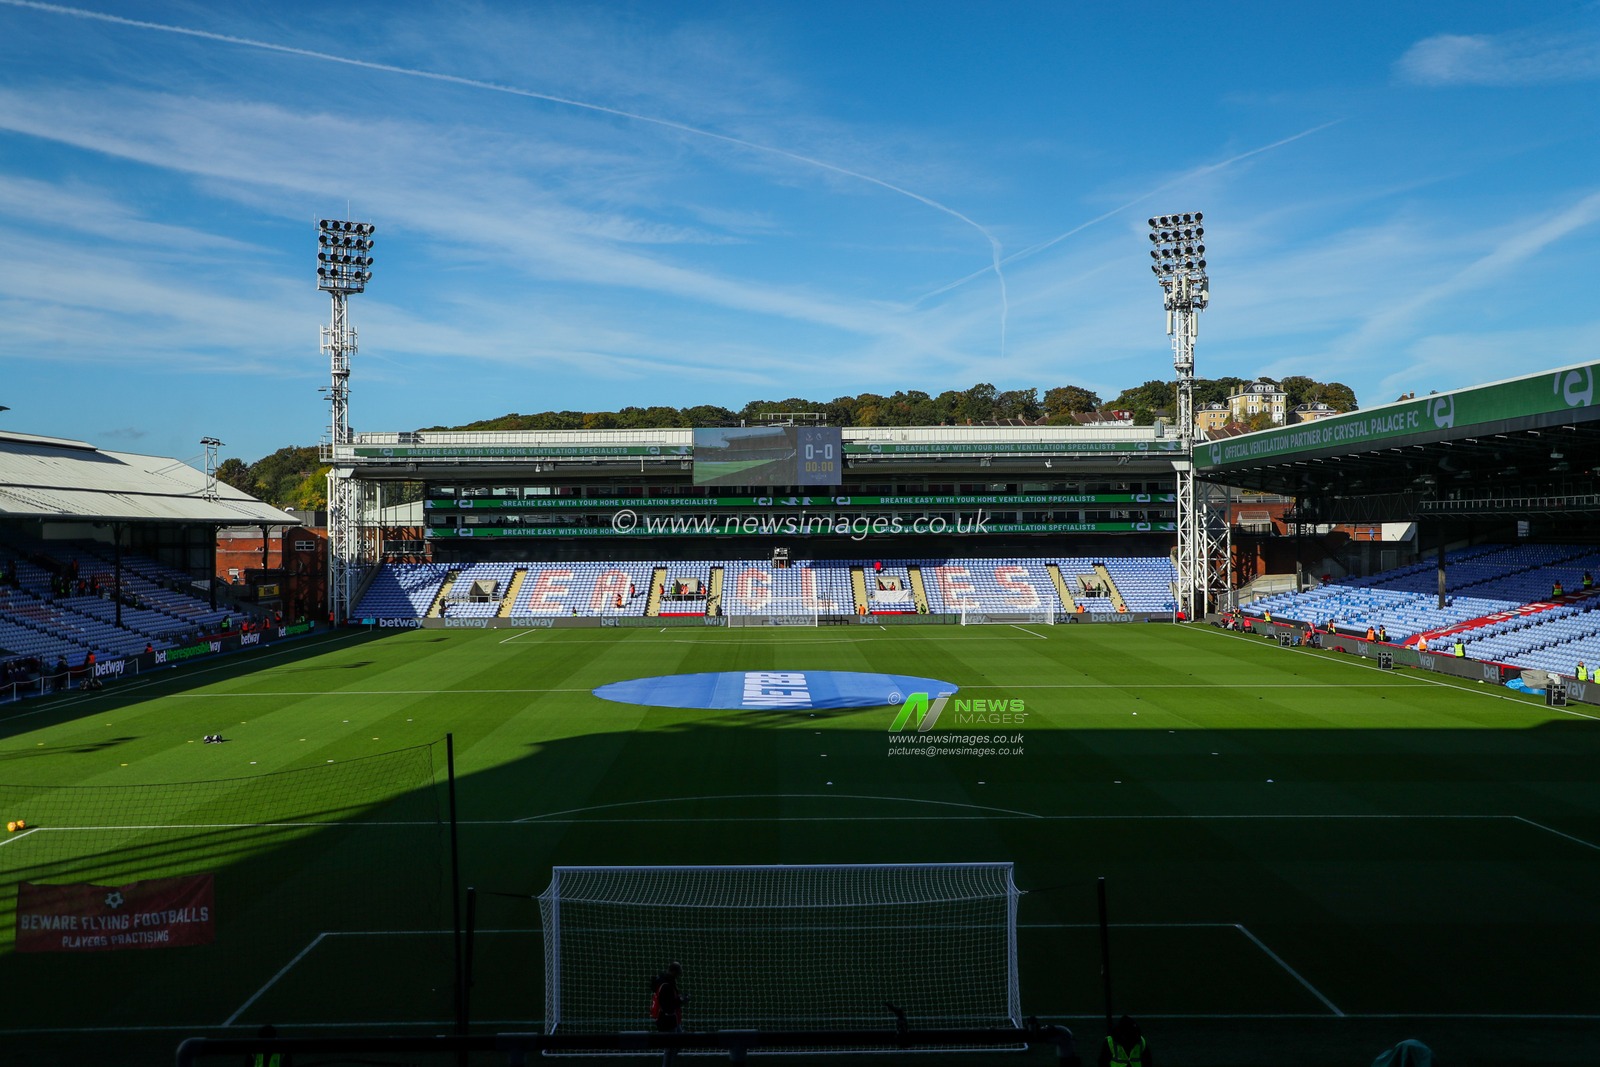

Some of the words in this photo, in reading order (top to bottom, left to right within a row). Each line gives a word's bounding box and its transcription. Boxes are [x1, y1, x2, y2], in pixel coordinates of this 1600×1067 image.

[1224, 446, 1248, 459] OFFICIAL
[1249, 438, 1289, 455] VENTILATION
[1290, 431, 1321, 448] PARTNER
[1322, 428, 1333, 442] OF
[1333, 420, 1369, 441] CRYSTAL
[1370, 412, 1404, 434] PALACE
[1405, 410, 1419, 427] FC
[806, 444, 832, 460] 0-0
[806, 462, 833, 472] 00:00
[379, 617, 423, 629] betway
[444, 617, 489, 628] betway
[510, 617, 555, 628] betway
[768, 615, 812, 626] betway
[1091, 612, 1135, 623] betway
[240, 632, 260, 645] betway
[95, 659, 126, 677] betway
[21, 914, 78, 930] BEWARE
[81, 914, 129, 931] FLYING
[133, 907, 209, 928] FOOTBALLS
[62, 935, 108, 948] PLAYERS
[112, 930, 169, 944] PRACTISING
